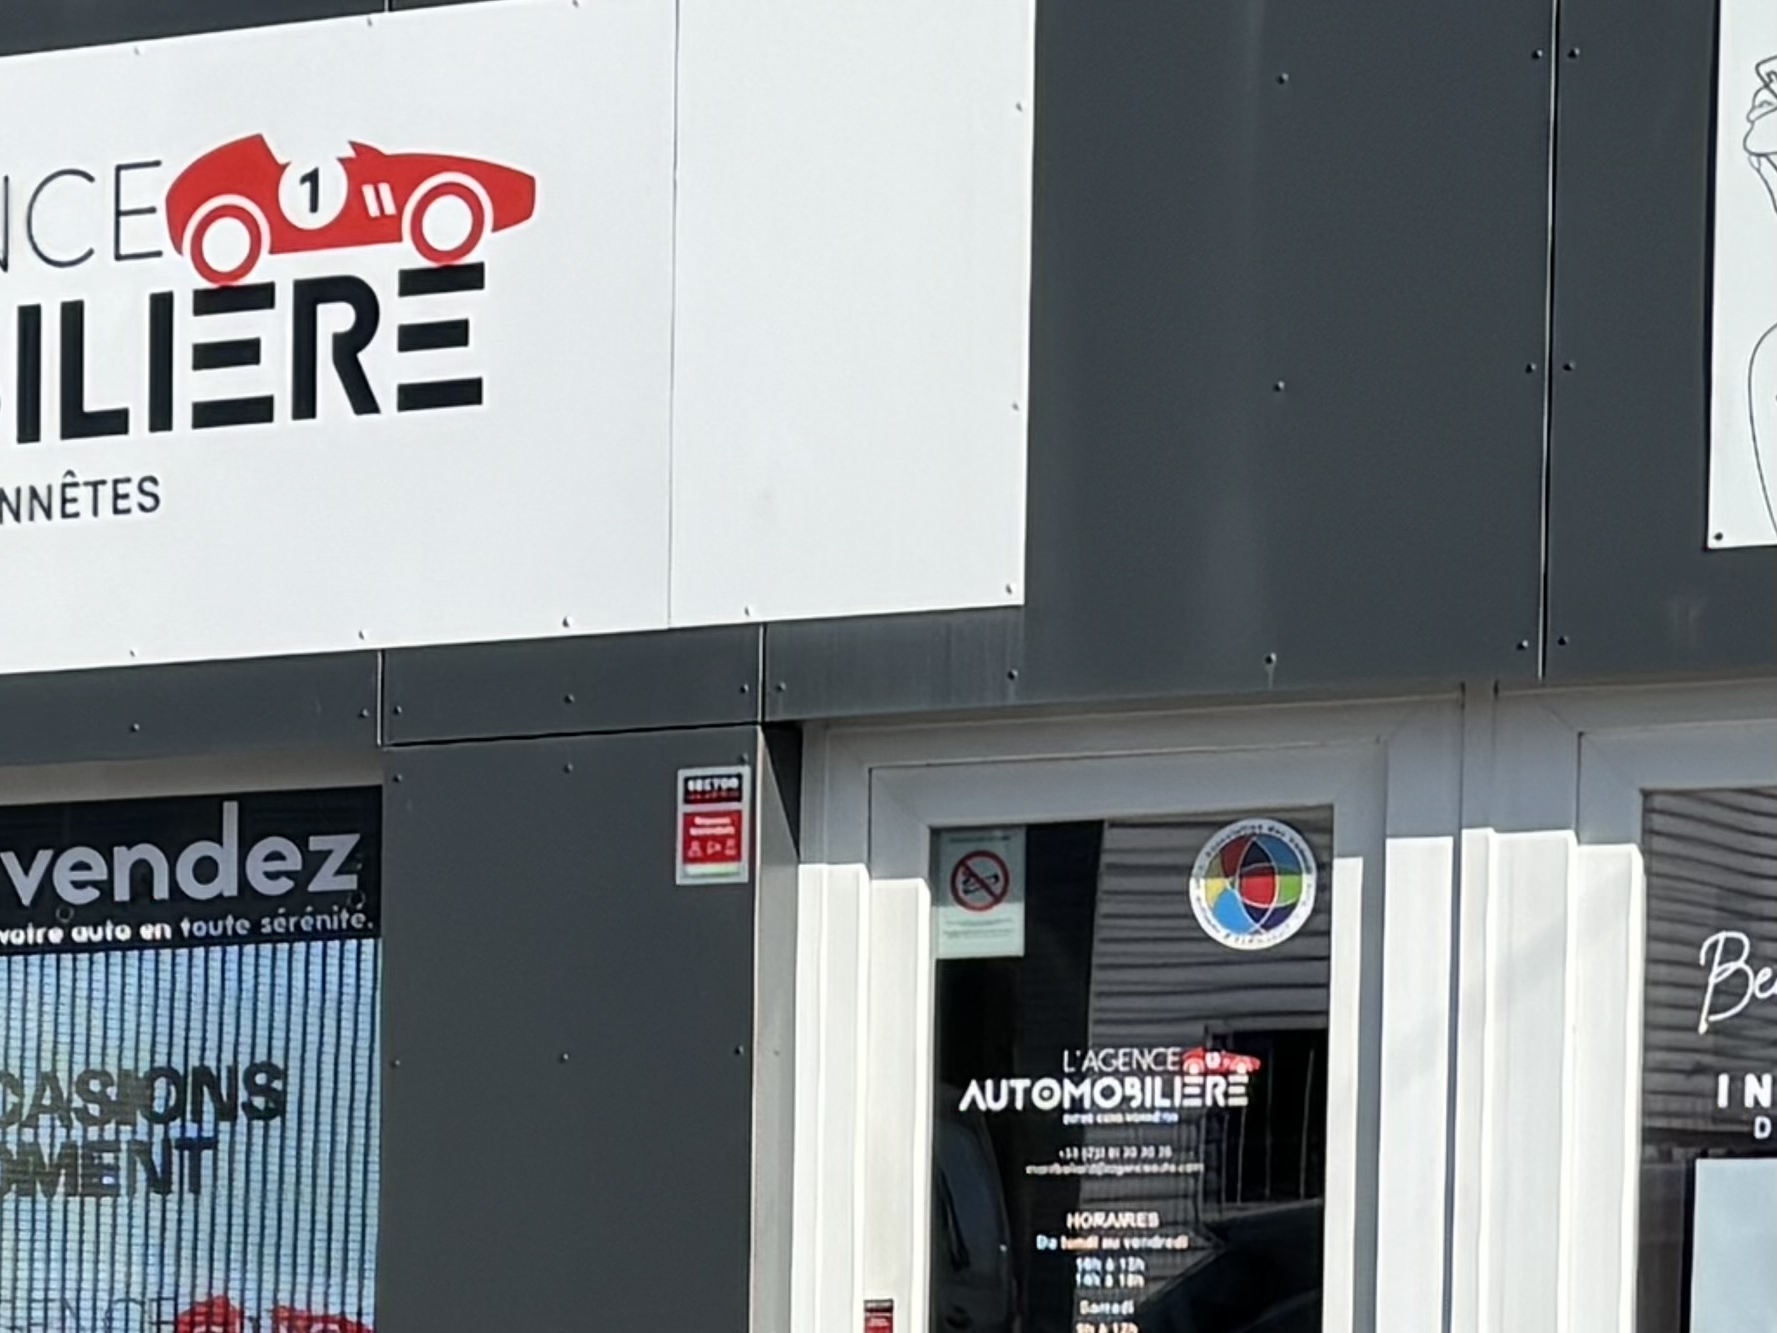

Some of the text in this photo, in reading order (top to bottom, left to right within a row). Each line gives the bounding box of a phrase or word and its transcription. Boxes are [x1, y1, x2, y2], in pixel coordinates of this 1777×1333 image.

[299, 166, 320, 214] 1
[0, 801, 361, 907] vendez
[71, 919, 132, 943] auto
[139, 923, 172, 941] en
[180, 916, 251, 938] toute
[259, 906, 374, 934] sérénité.
[1062, 1047, 1181, 1073] L'AGENCE
[1066, 1211, 1160, 1229] HORAIRES
[1060, 1235, 1099, 1250] lundi
[1123, 1234, 1188, 1250] vendredi
[1080, 1300, 1134, 1314] Samedi
